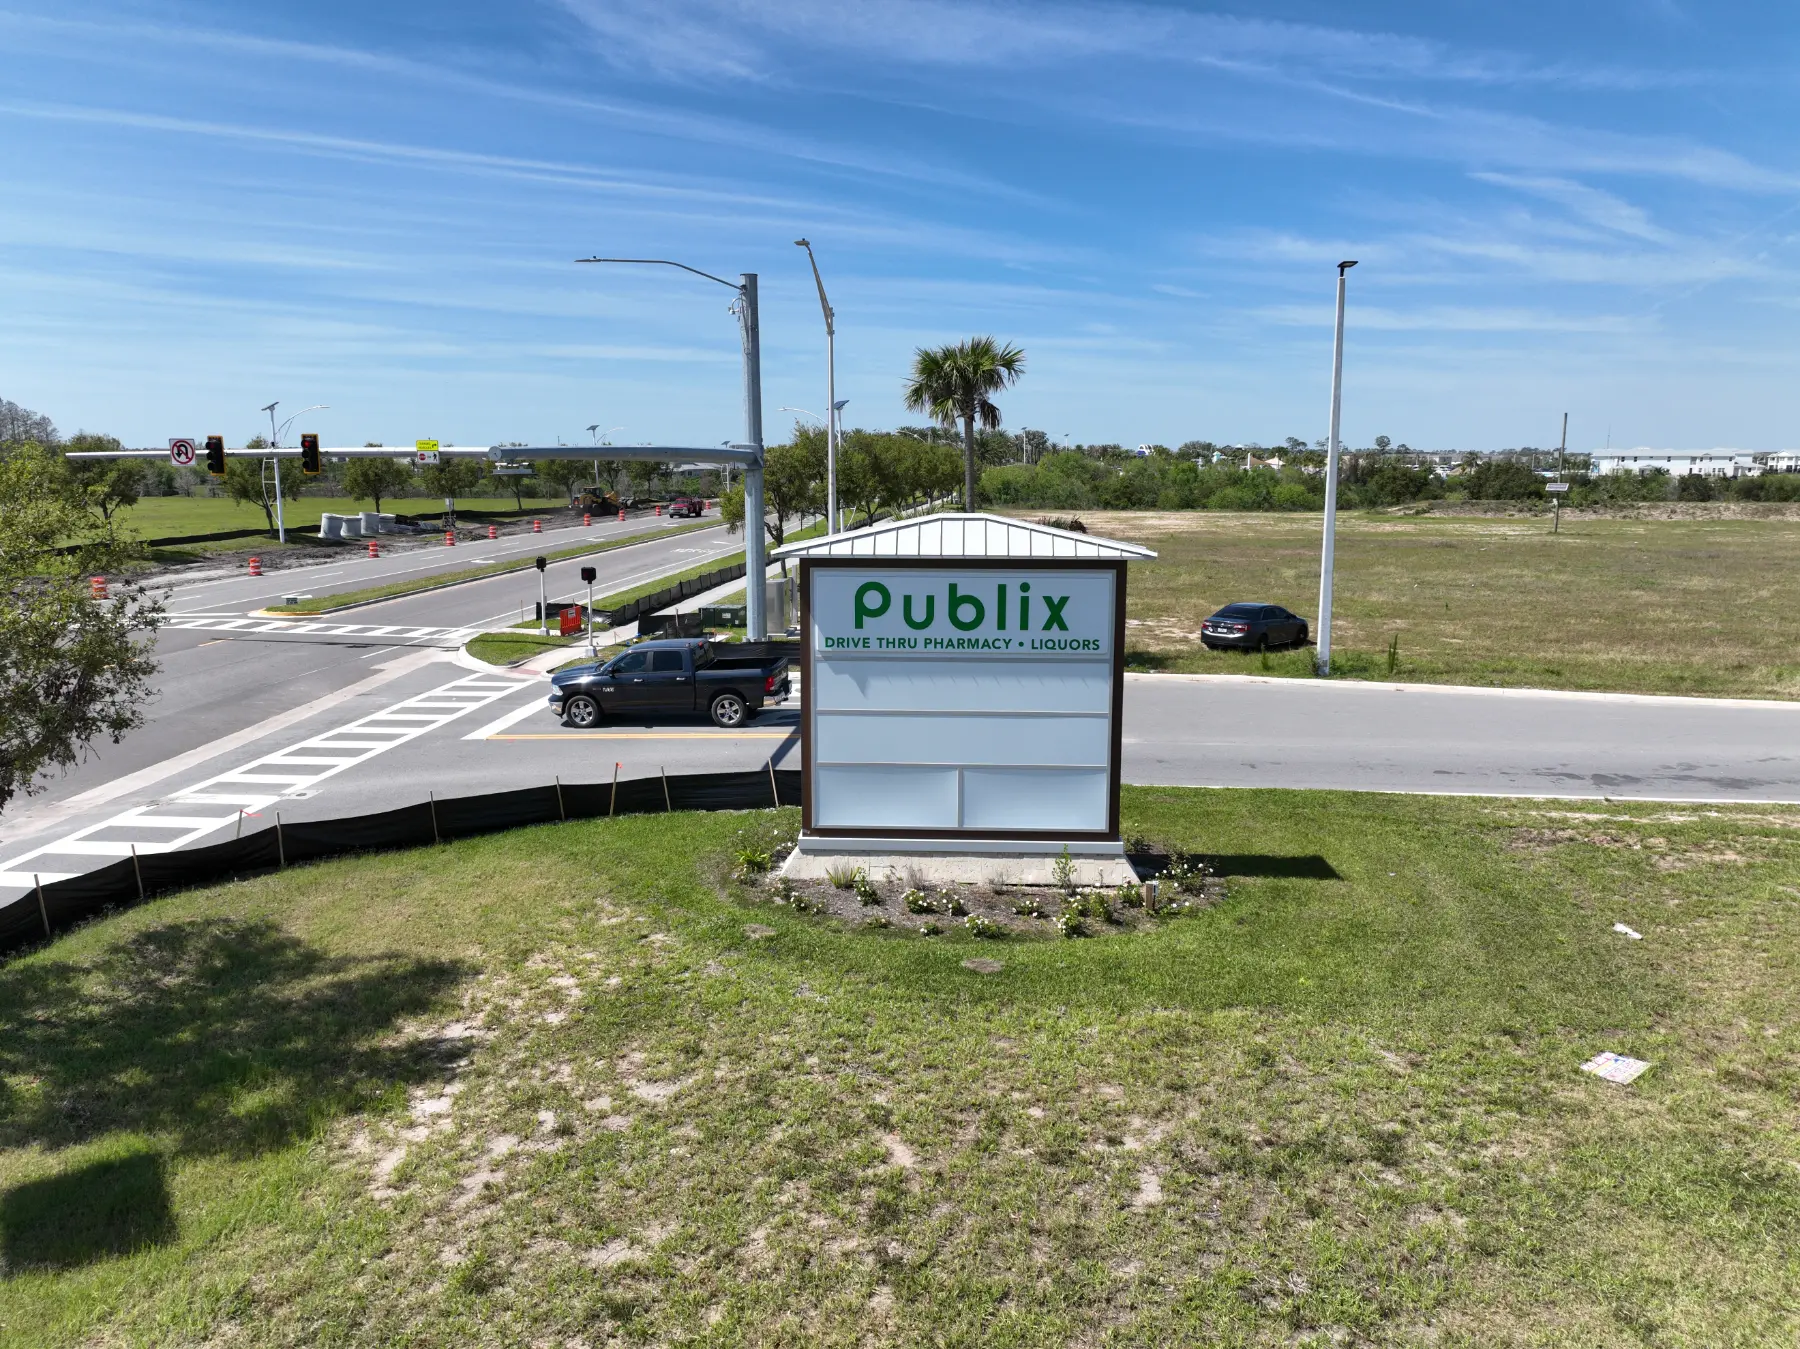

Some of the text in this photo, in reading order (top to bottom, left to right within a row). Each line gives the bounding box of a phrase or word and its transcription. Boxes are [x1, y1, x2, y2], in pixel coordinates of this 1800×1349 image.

[854, 581, 1070, 632] Publix
[824, 637, 871, 649] DRIVE
[876, 637, 918, 649] THRU
[923, 638, 1012, 650] PHARMACY
[1031, 639, 1101, 651] LIQUORS
